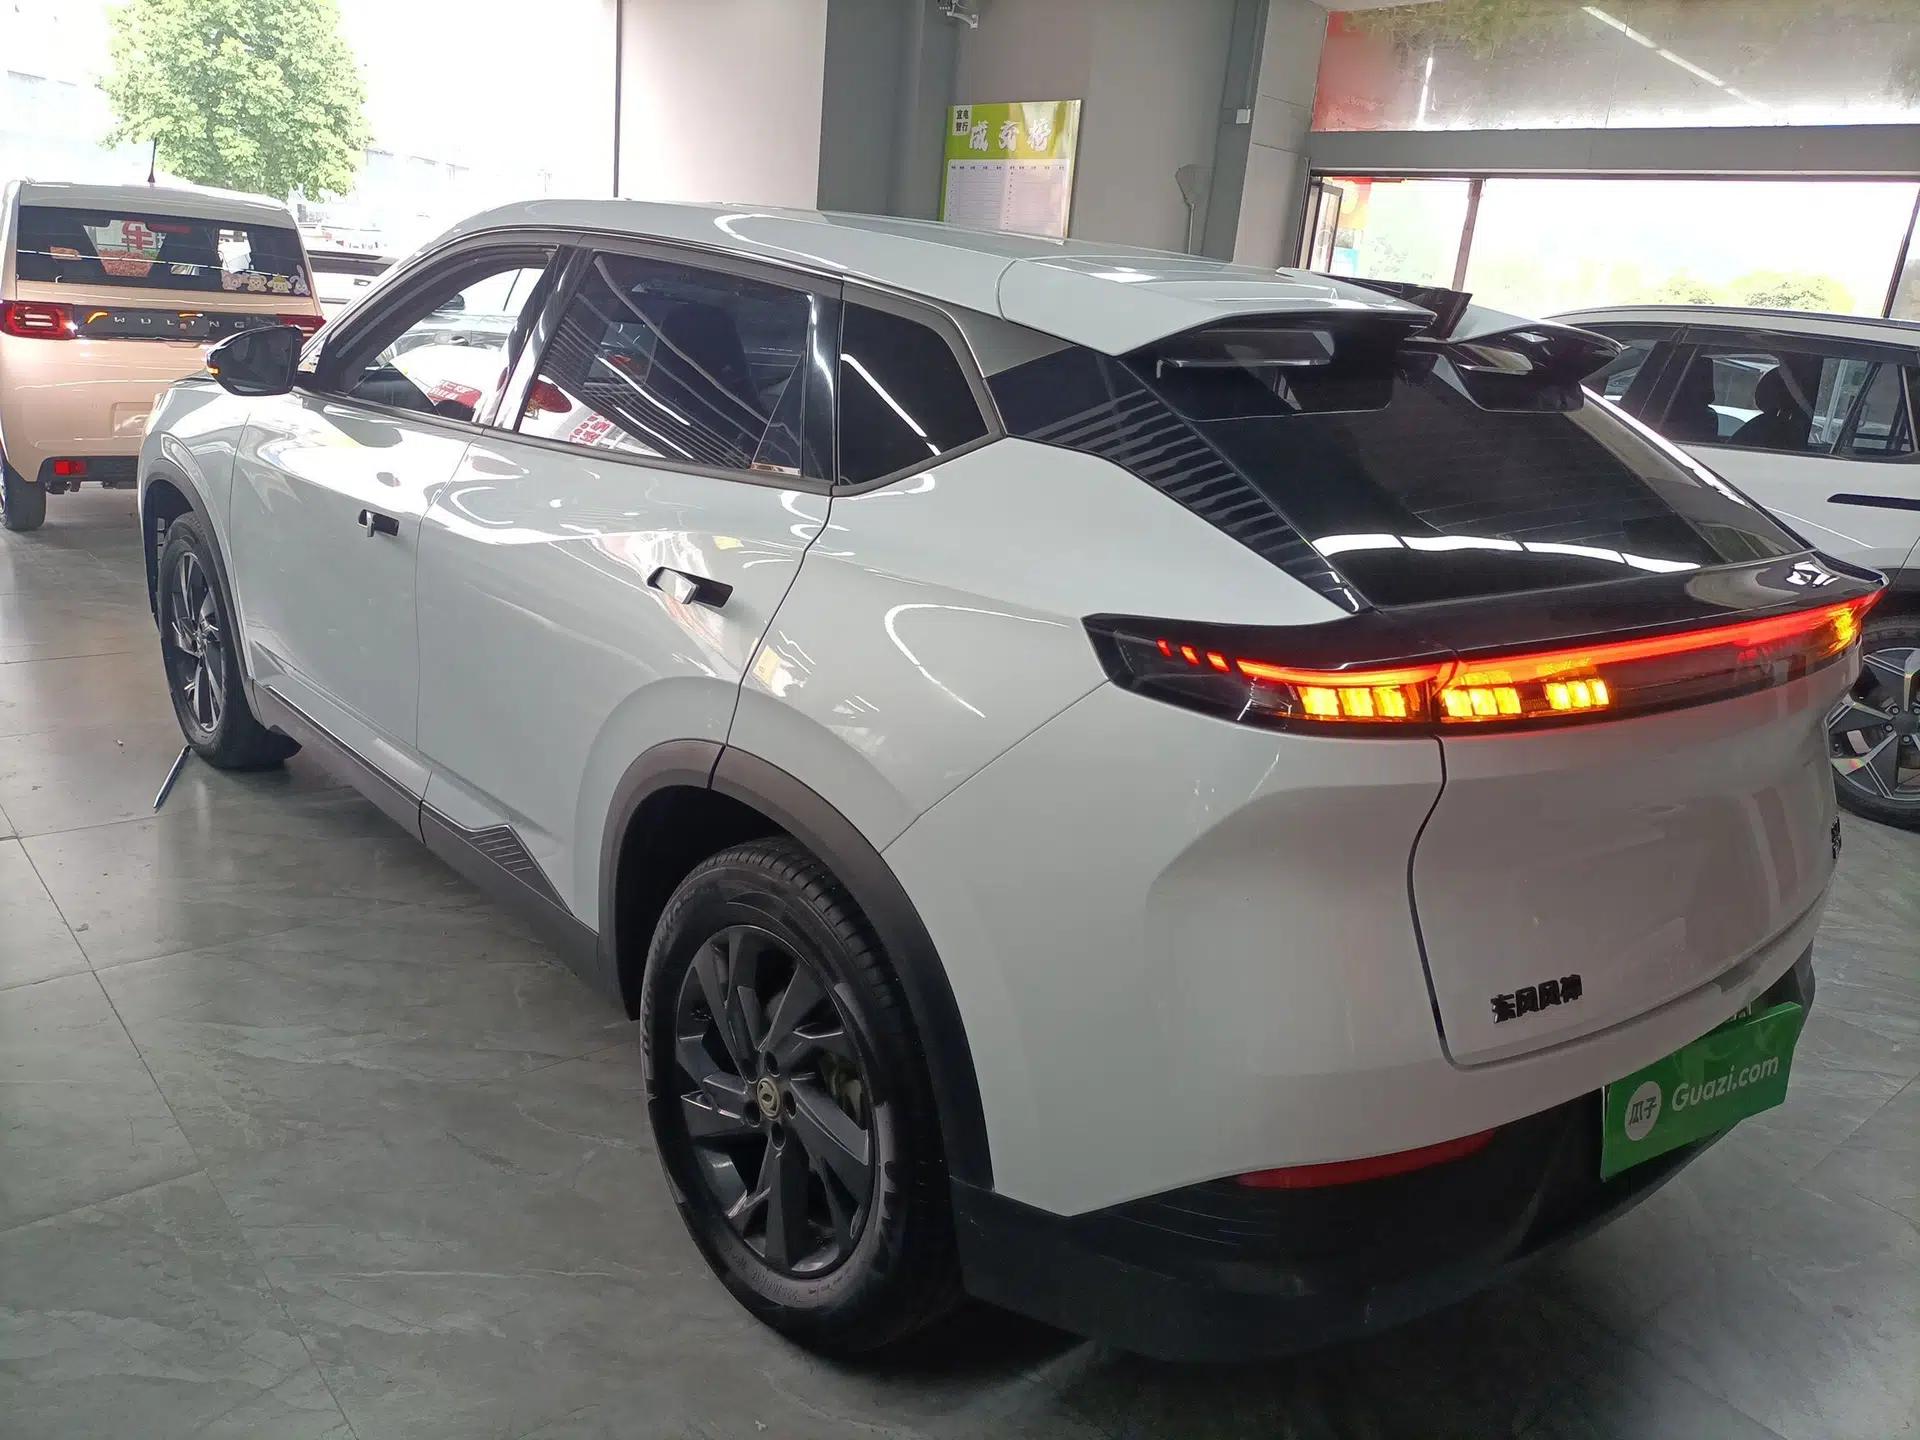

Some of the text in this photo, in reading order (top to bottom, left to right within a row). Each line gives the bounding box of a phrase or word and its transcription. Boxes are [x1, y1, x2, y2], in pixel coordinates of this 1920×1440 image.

[1490, 974, 1583, 1024] 东风风神
[1671, 1056, 1780, 1112] Guazi.com
[1628, 1096, 1657, 1127] 瓜子
